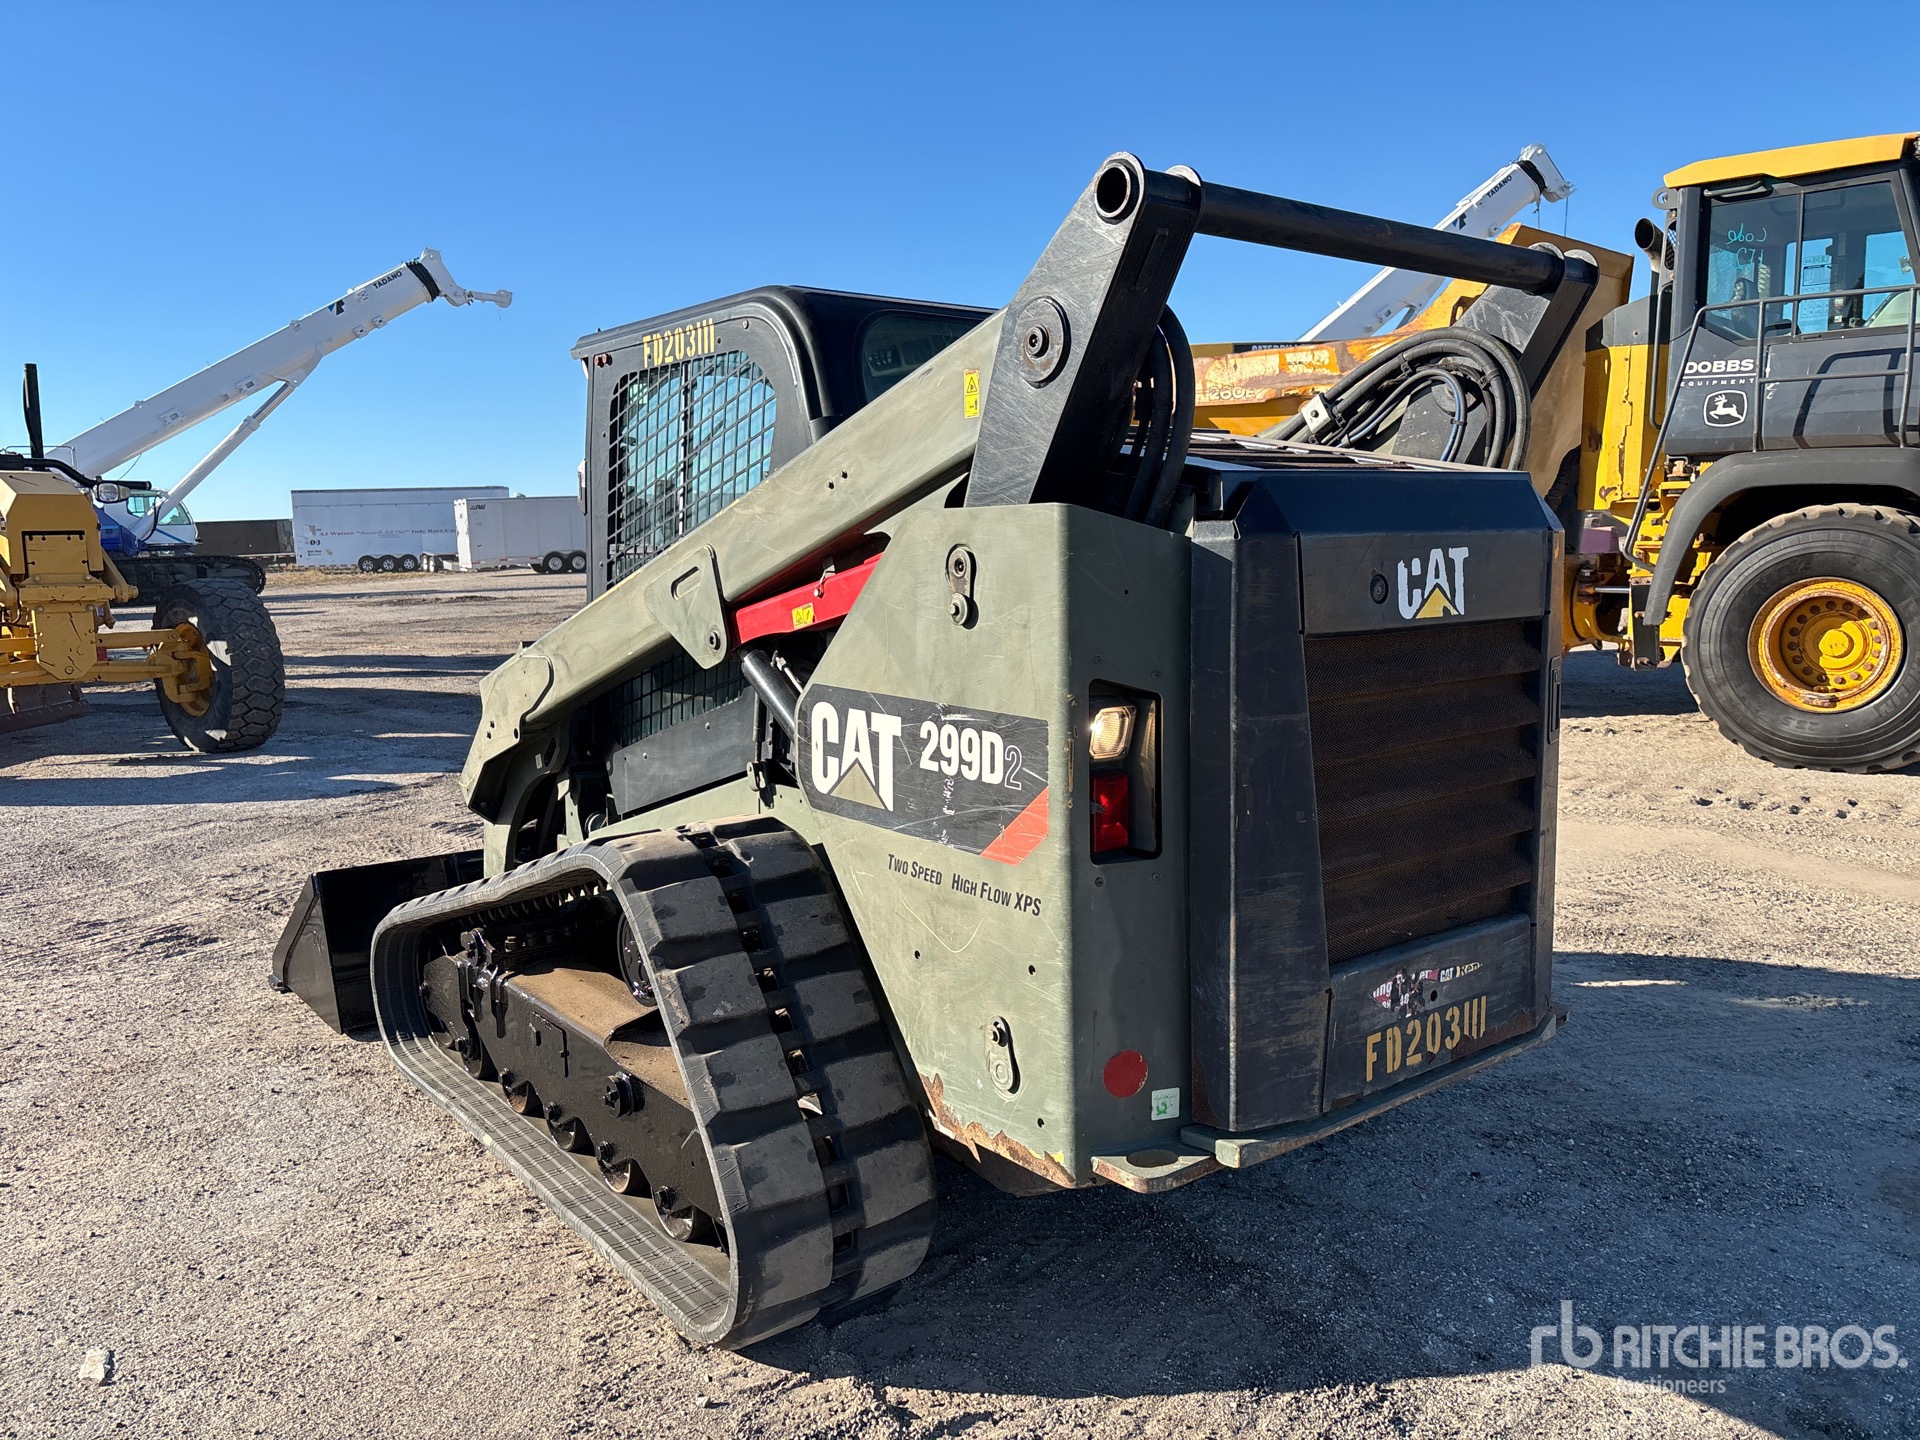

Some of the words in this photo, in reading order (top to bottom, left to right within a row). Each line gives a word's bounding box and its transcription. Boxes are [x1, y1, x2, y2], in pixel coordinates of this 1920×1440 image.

[1486, 174, 1513, 198] TADANO
[372, 270, 403, 289] TADANO
[1684, 358, 1755, 374] DOBBS
[1680, 377, 1755, 387] EQUIPMENT
[1397, 546, 1469, 620] CAT
[811, 701, 902, 812] CAT
[1014, 891, 1042, 917] XPS
[1440, 967, 1455, 983] CAT
